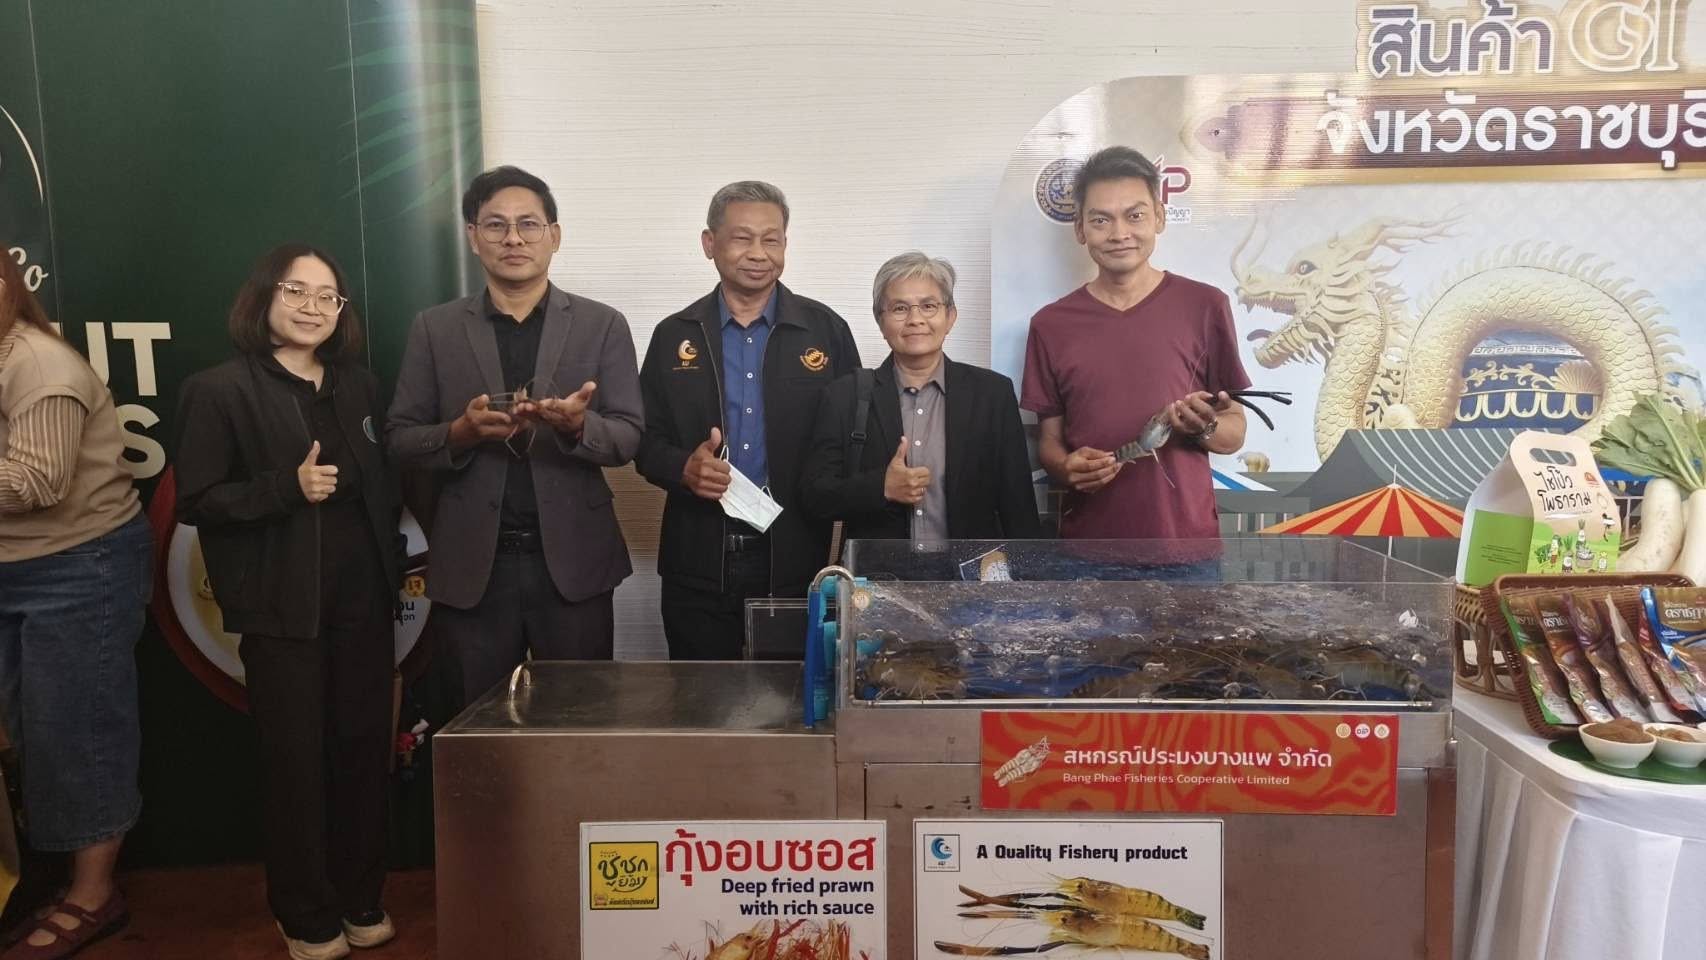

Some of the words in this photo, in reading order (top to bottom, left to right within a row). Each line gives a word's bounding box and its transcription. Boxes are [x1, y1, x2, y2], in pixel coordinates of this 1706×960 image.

[1370, 0, 1553, 77] สินค้า
[1568, 0, 1679, 71] GI
[1537, 489, 1592, 512] โพธาราม
[1063, 745, 1272, 766] สหกรณ์ประมงบางแพ
[1278, 746, 1332, 767] จำกัด
[1063, 772, 1091, 784] Bang
[1094, 773, 1121, 783] Phae
[1124, 773, 1174, 783] Fisheries
[1177, 774, 1244, 786] Cooperative
[1247, 775, 1290, 785] Limited
[665, 828, 877, 887] กุ้งอบซอส
[977, 844, 988, 859] A
[995, 844, 1051, 862] Quality
[1059, 844, 1118, 863] Fishery
[1125, 846, 1188, 862] product
[721, 878, 767, 897] Deep
[771, 877, 814, 893] fried
[819, 881, 874, 897] prawn
[740, 900, 779, 915] with
[784, 900, 817, 915] rich
[822, 903, 874, 915] sauce
